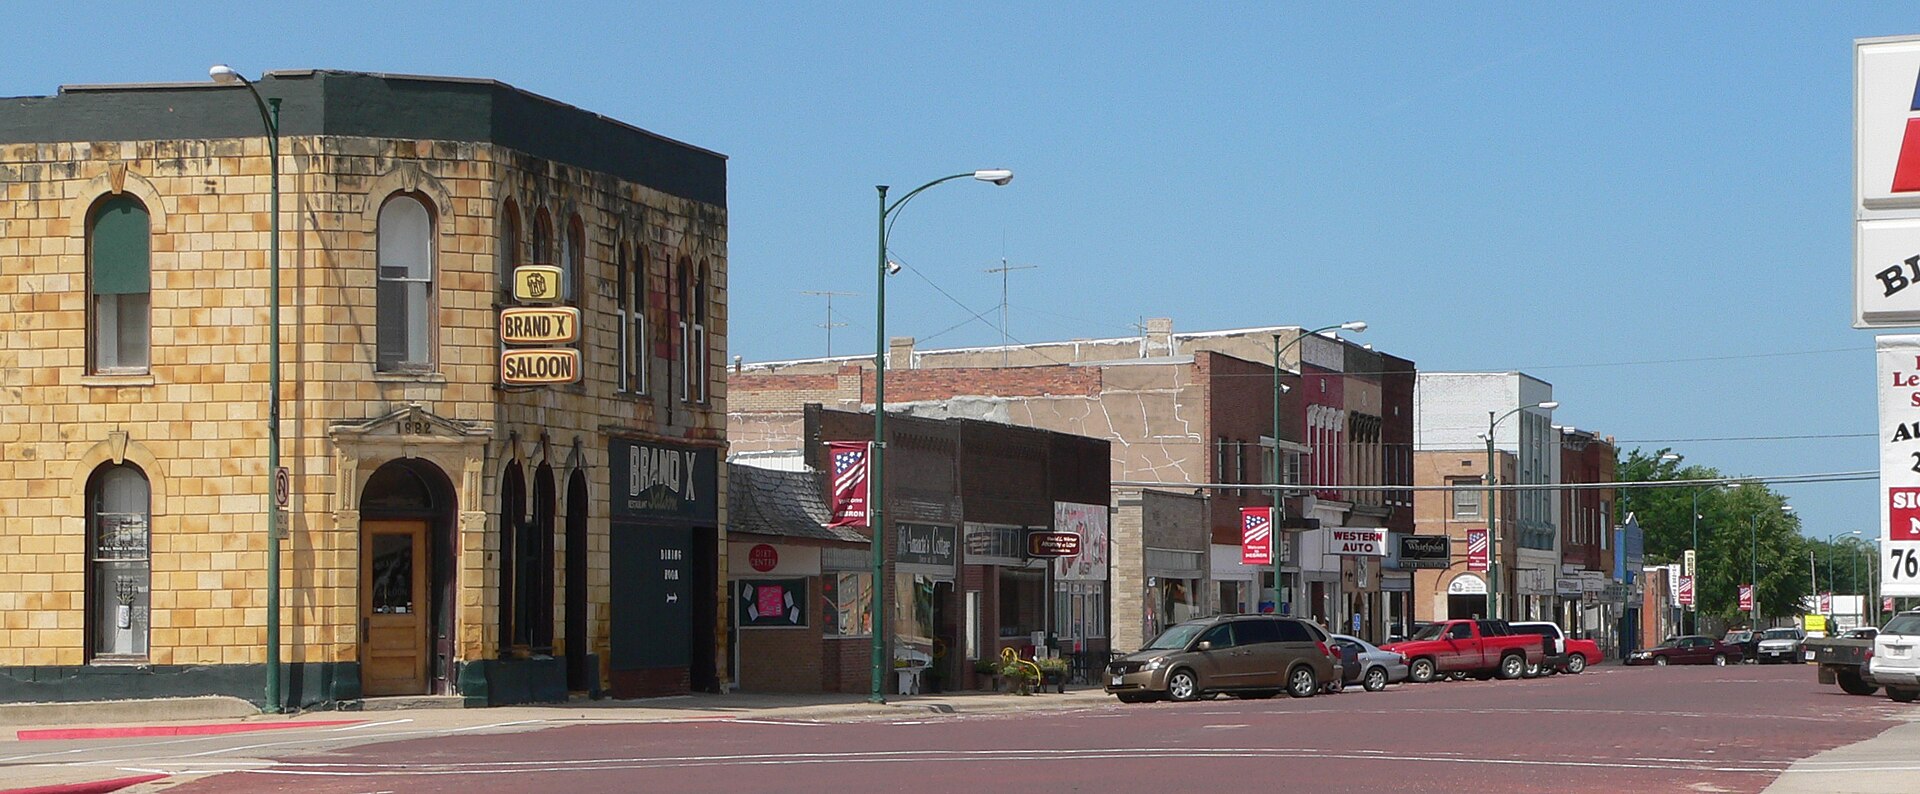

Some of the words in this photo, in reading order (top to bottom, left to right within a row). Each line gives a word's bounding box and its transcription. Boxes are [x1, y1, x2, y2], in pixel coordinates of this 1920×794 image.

[505, 316, 551, 337] BRAND
[506, 356, 571, 378] SALOON
[396, 421, 432, 434] 1882
[630, 445, 680, 496] BRAND
[685, 451, 696, 501] X
[1893, 491, 1920, 509] SI
[1334, 531, 1383, 542] WESTERN
[755, 549, 772, 558] DIET
[1342, 542, 1373, 553] AUTO
[1408, 542, 1445, 553] Whirlpool
[751, 558, 777, 567] CENTER
